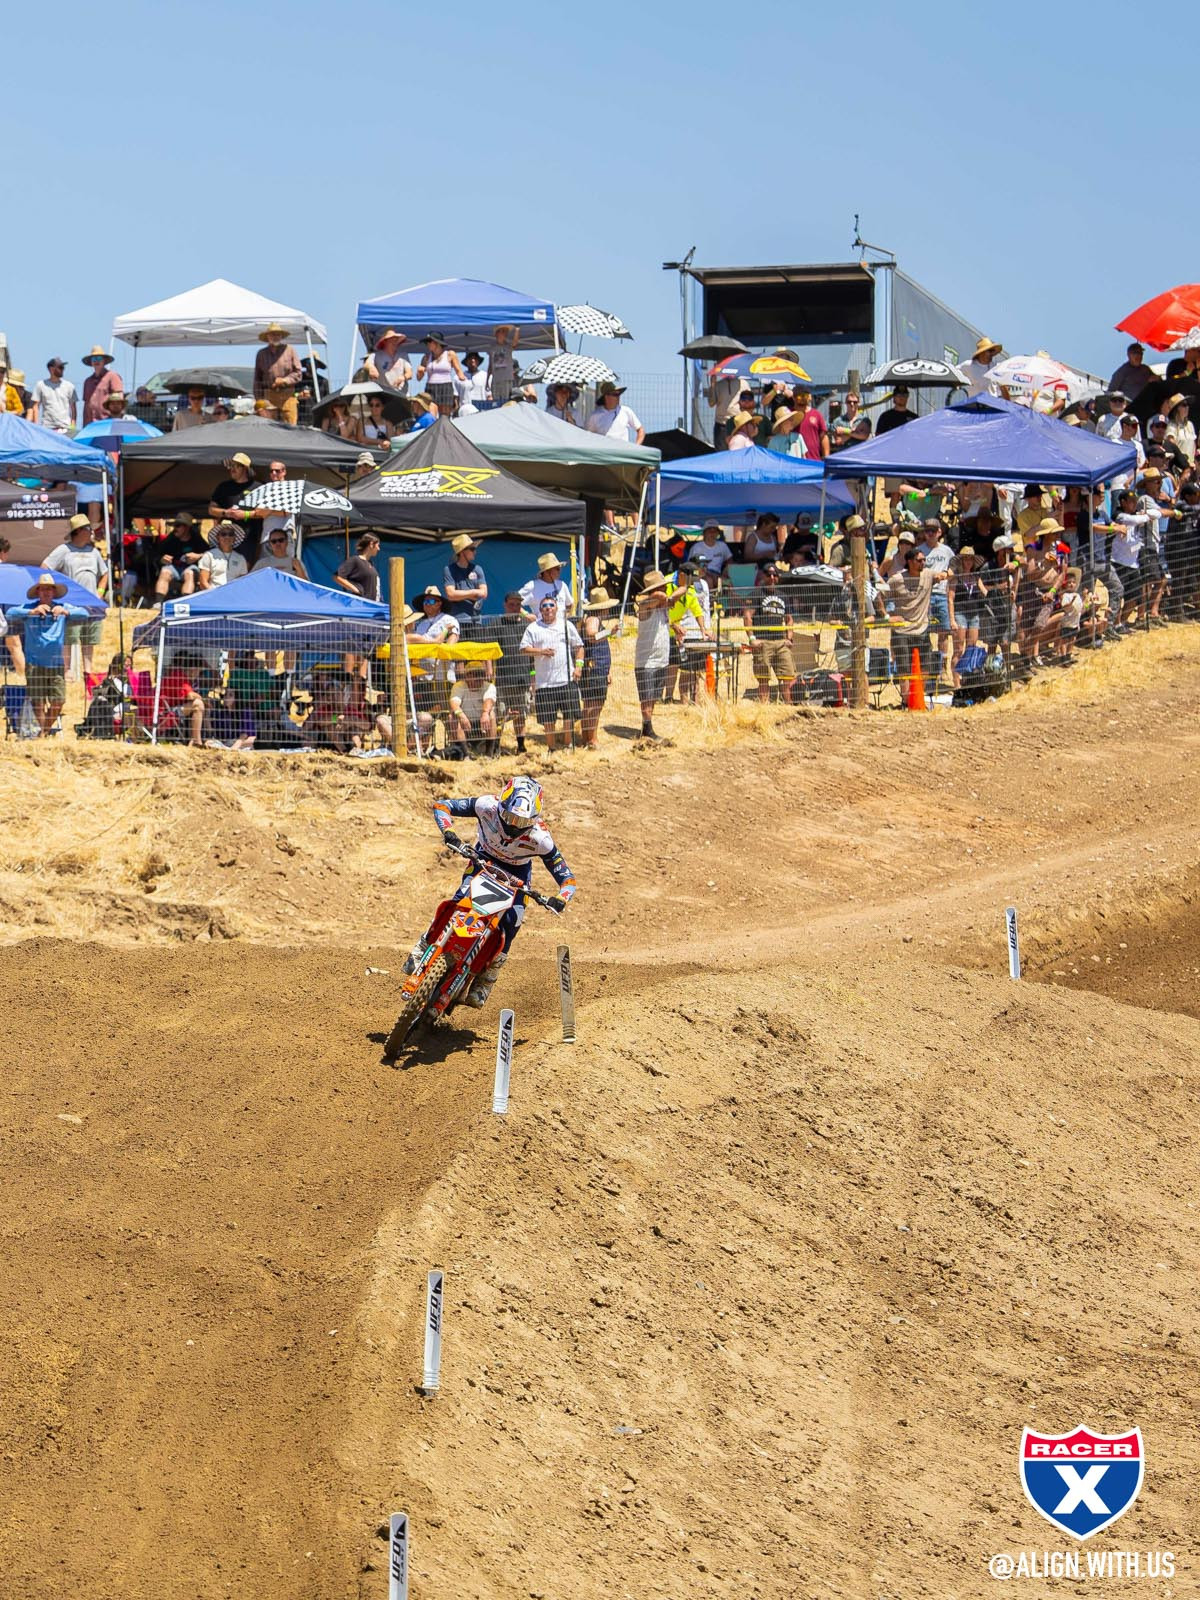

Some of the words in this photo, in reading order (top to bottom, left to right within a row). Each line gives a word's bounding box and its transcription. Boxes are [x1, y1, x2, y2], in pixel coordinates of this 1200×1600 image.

[384, 479, 440, 488] MOTO
[471, 881, 511, 906] 7
[500, 1030, 509, 1063] UFO
[429, 1295, 439, 1332] UFO
[392, 1541, 401, 1581] UFO
